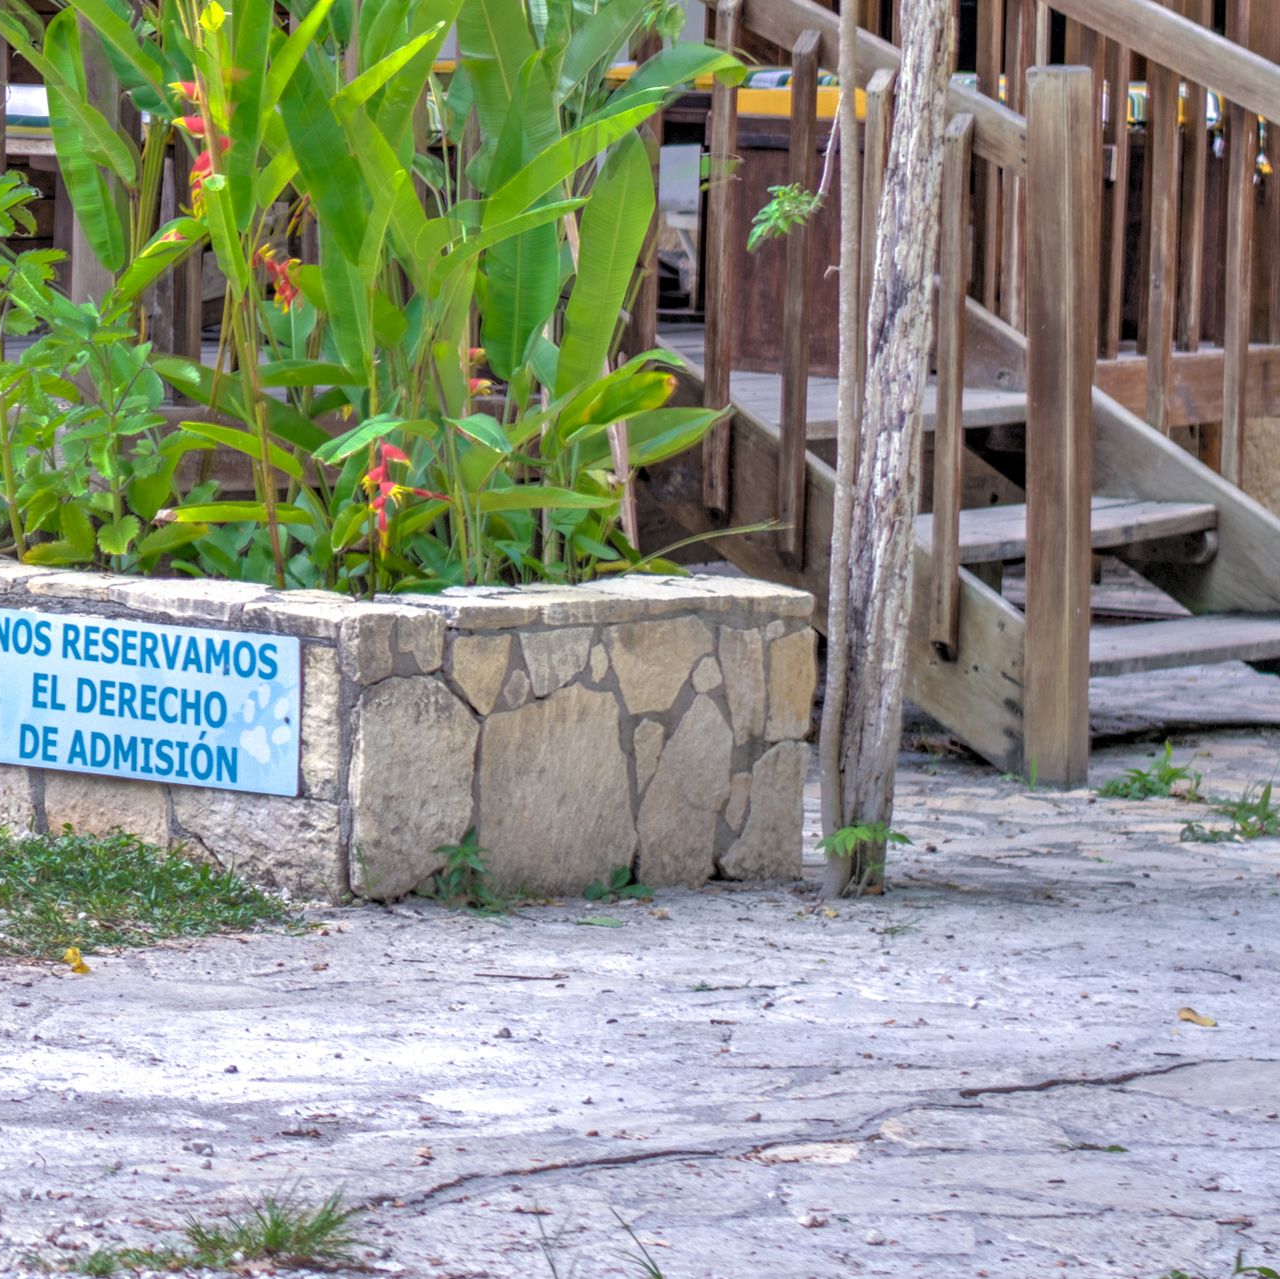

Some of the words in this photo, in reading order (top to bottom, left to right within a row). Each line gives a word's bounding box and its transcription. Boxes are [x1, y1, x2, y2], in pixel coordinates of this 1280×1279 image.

[61, 623, 278, 680] RESERVAMOS
[32, 672, 66, 711] EL
[76, 677, 228, 728] DERECHO
[19, 723, 58, 763] DE
[67, 729, 238, 784] ADMISIÓN
